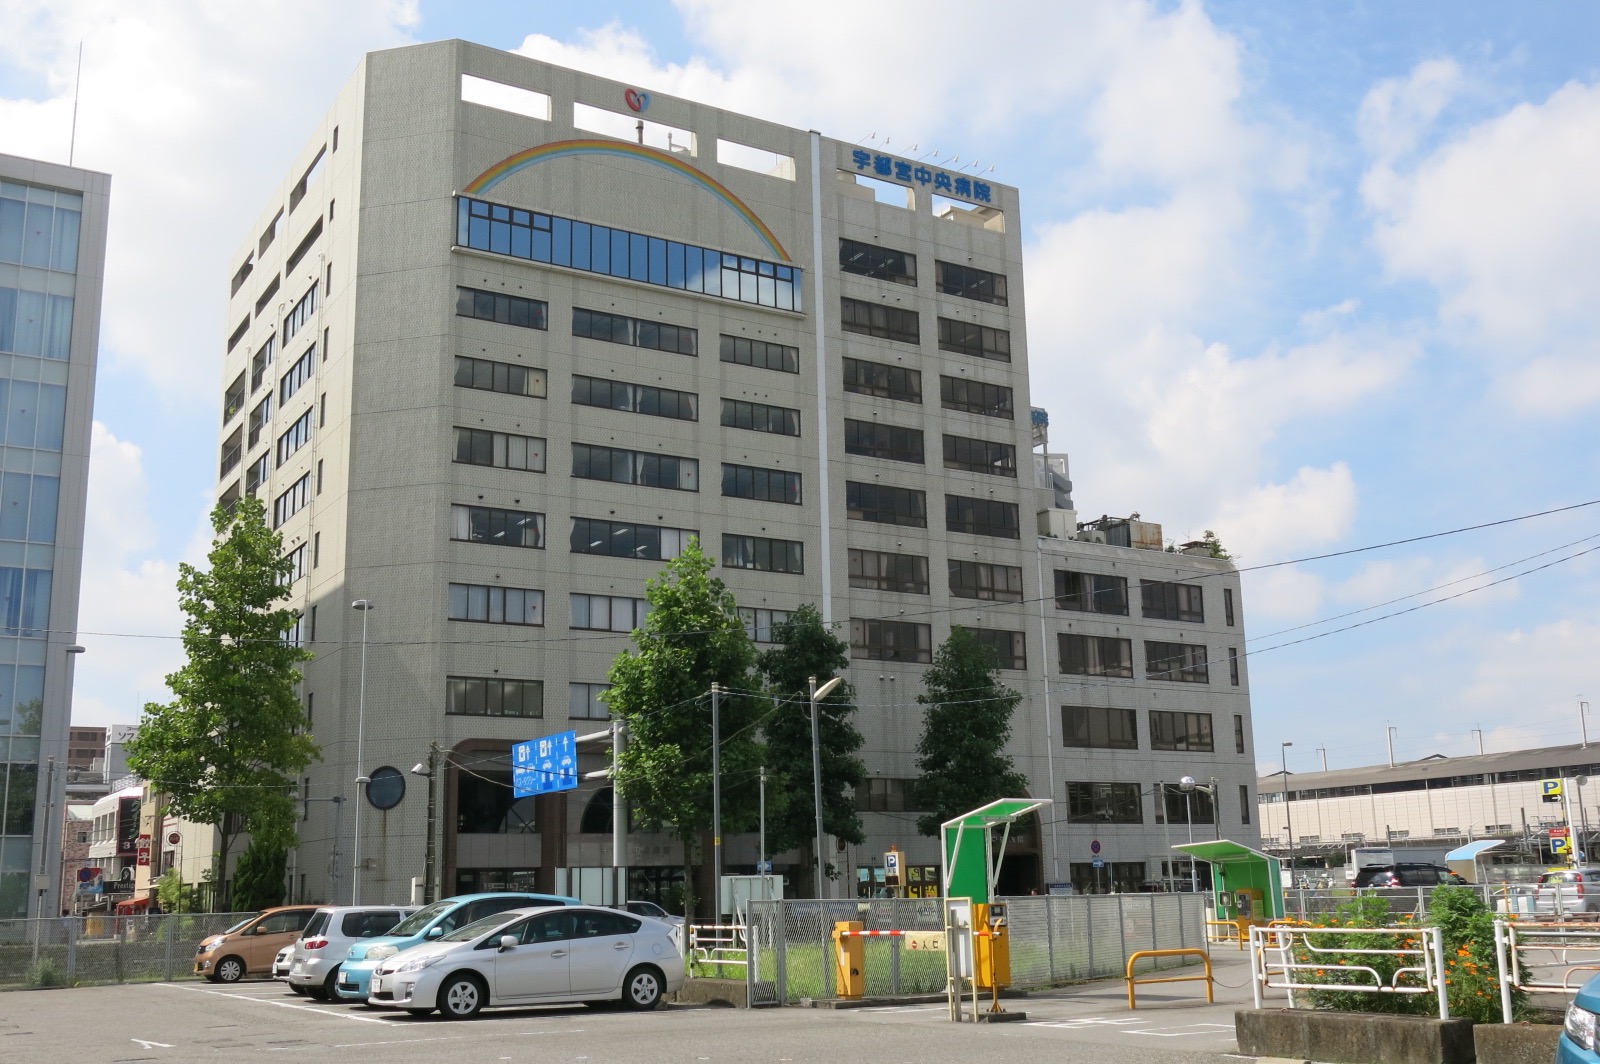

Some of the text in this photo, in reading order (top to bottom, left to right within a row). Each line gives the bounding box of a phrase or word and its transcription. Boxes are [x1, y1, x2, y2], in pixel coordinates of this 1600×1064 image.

[852, 149, 992, 203] 宇都宮中央病院
[1543, 781, 1559, 794] P
[1551, 838, 1566, 853] P
[887, 856, 896, 867] P
[922, 940, 939, 949] 入口
